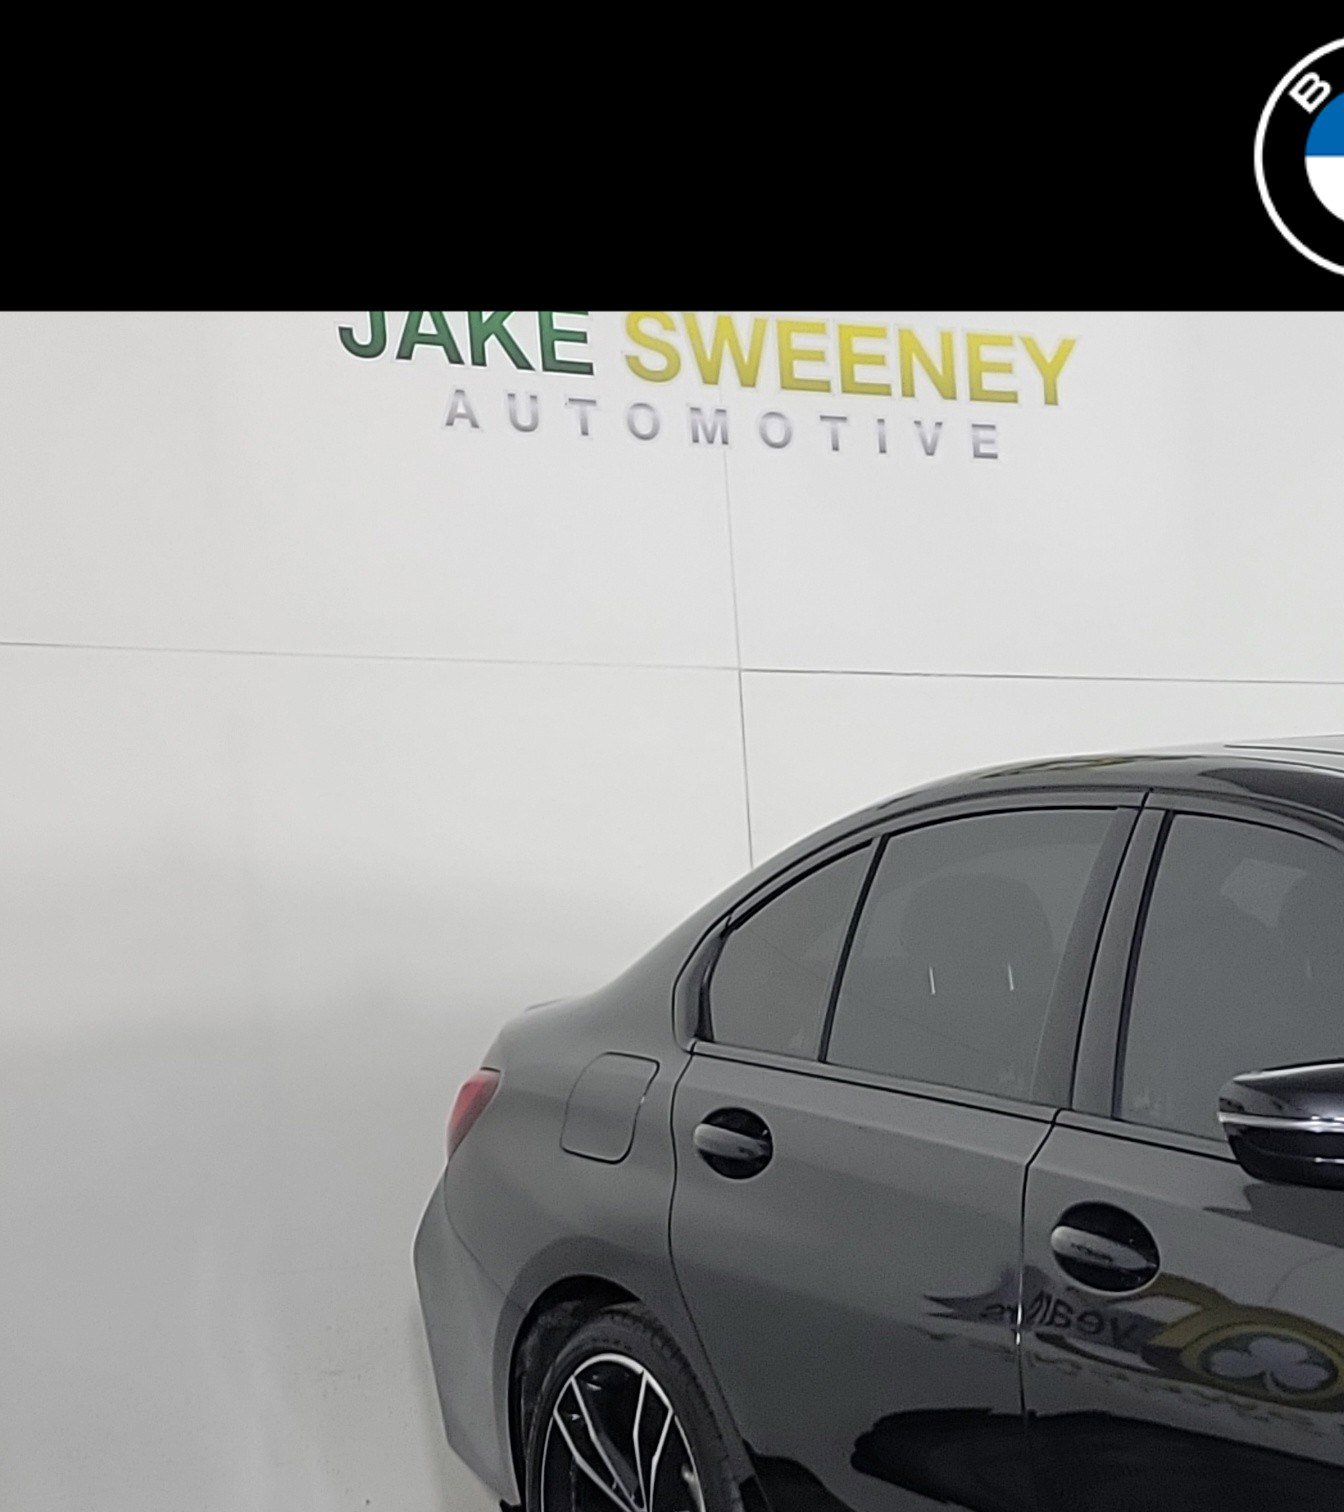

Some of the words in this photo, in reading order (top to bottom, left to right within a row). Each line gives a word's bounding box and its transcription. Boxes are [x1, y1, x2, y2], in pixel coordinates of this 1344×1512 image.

[338, 311, 595, 376] JAKE
[624, 311, 1077, 406] SWEENEY
[445, 388, 999, 460] AUTOMOTIVE
